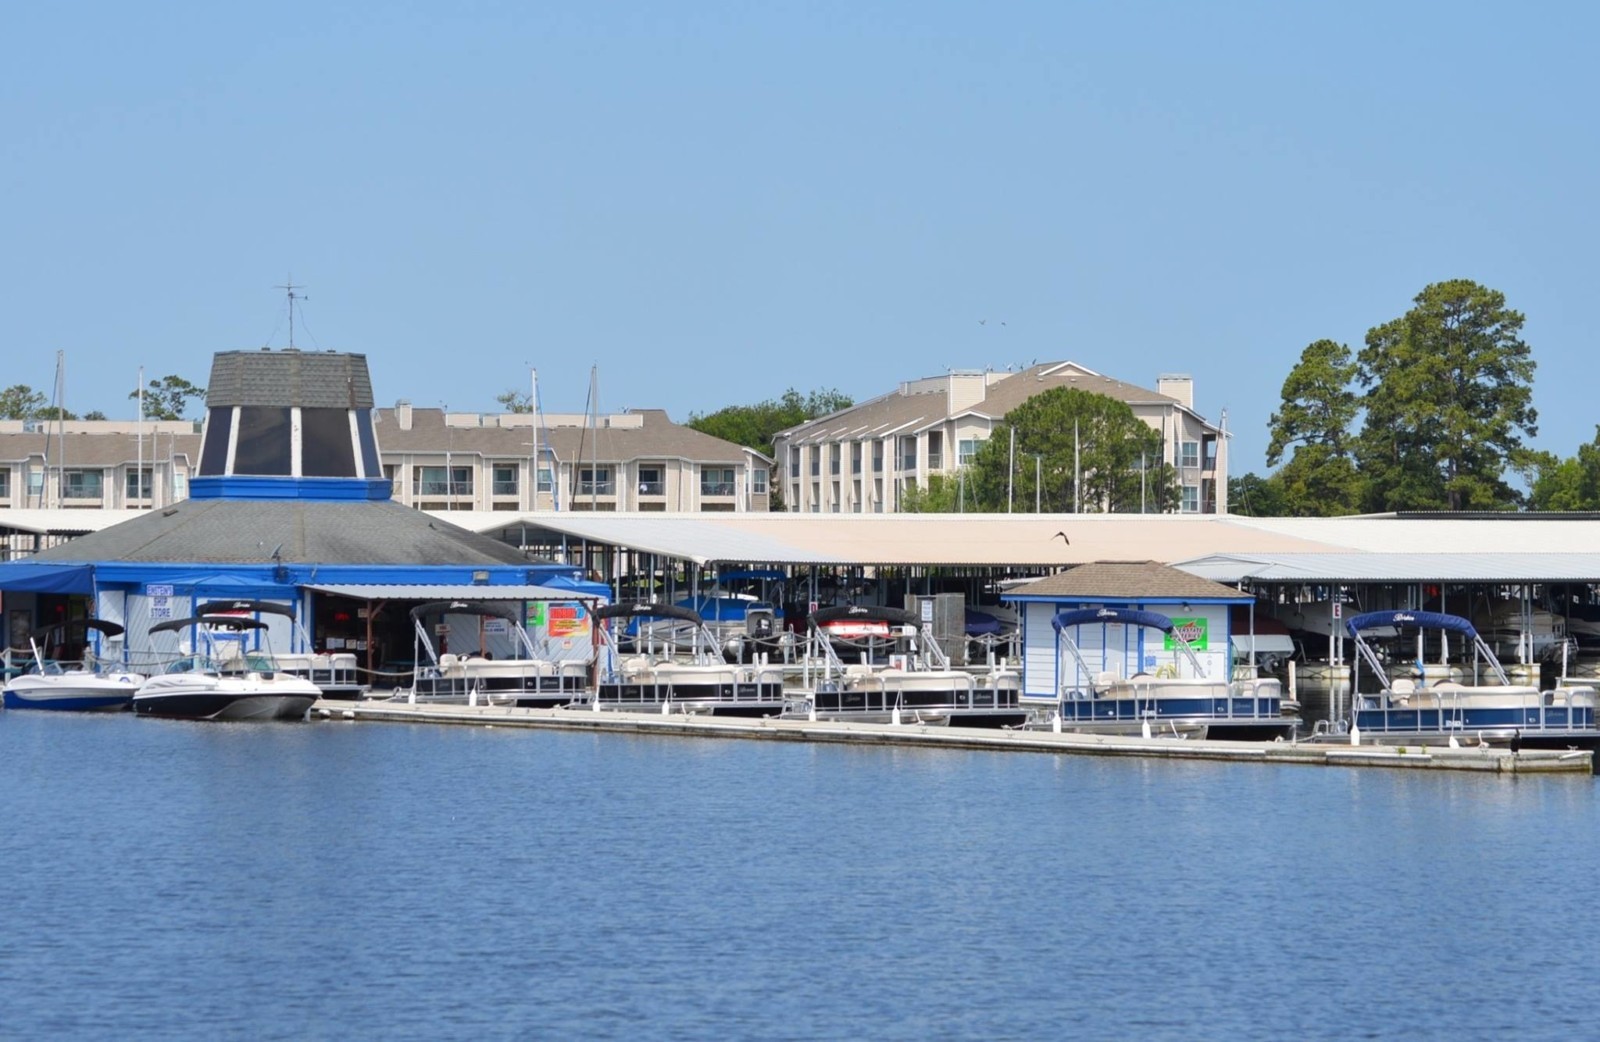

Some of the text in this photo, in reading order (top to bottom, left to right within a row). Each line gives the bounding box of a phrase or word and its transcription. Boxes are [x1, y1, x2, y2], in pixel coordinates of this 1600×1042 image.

[153, 596, 168, 607] SHIP
[150, 608, 171, 617] STORE
[1335, 604, 1340, 617] E
